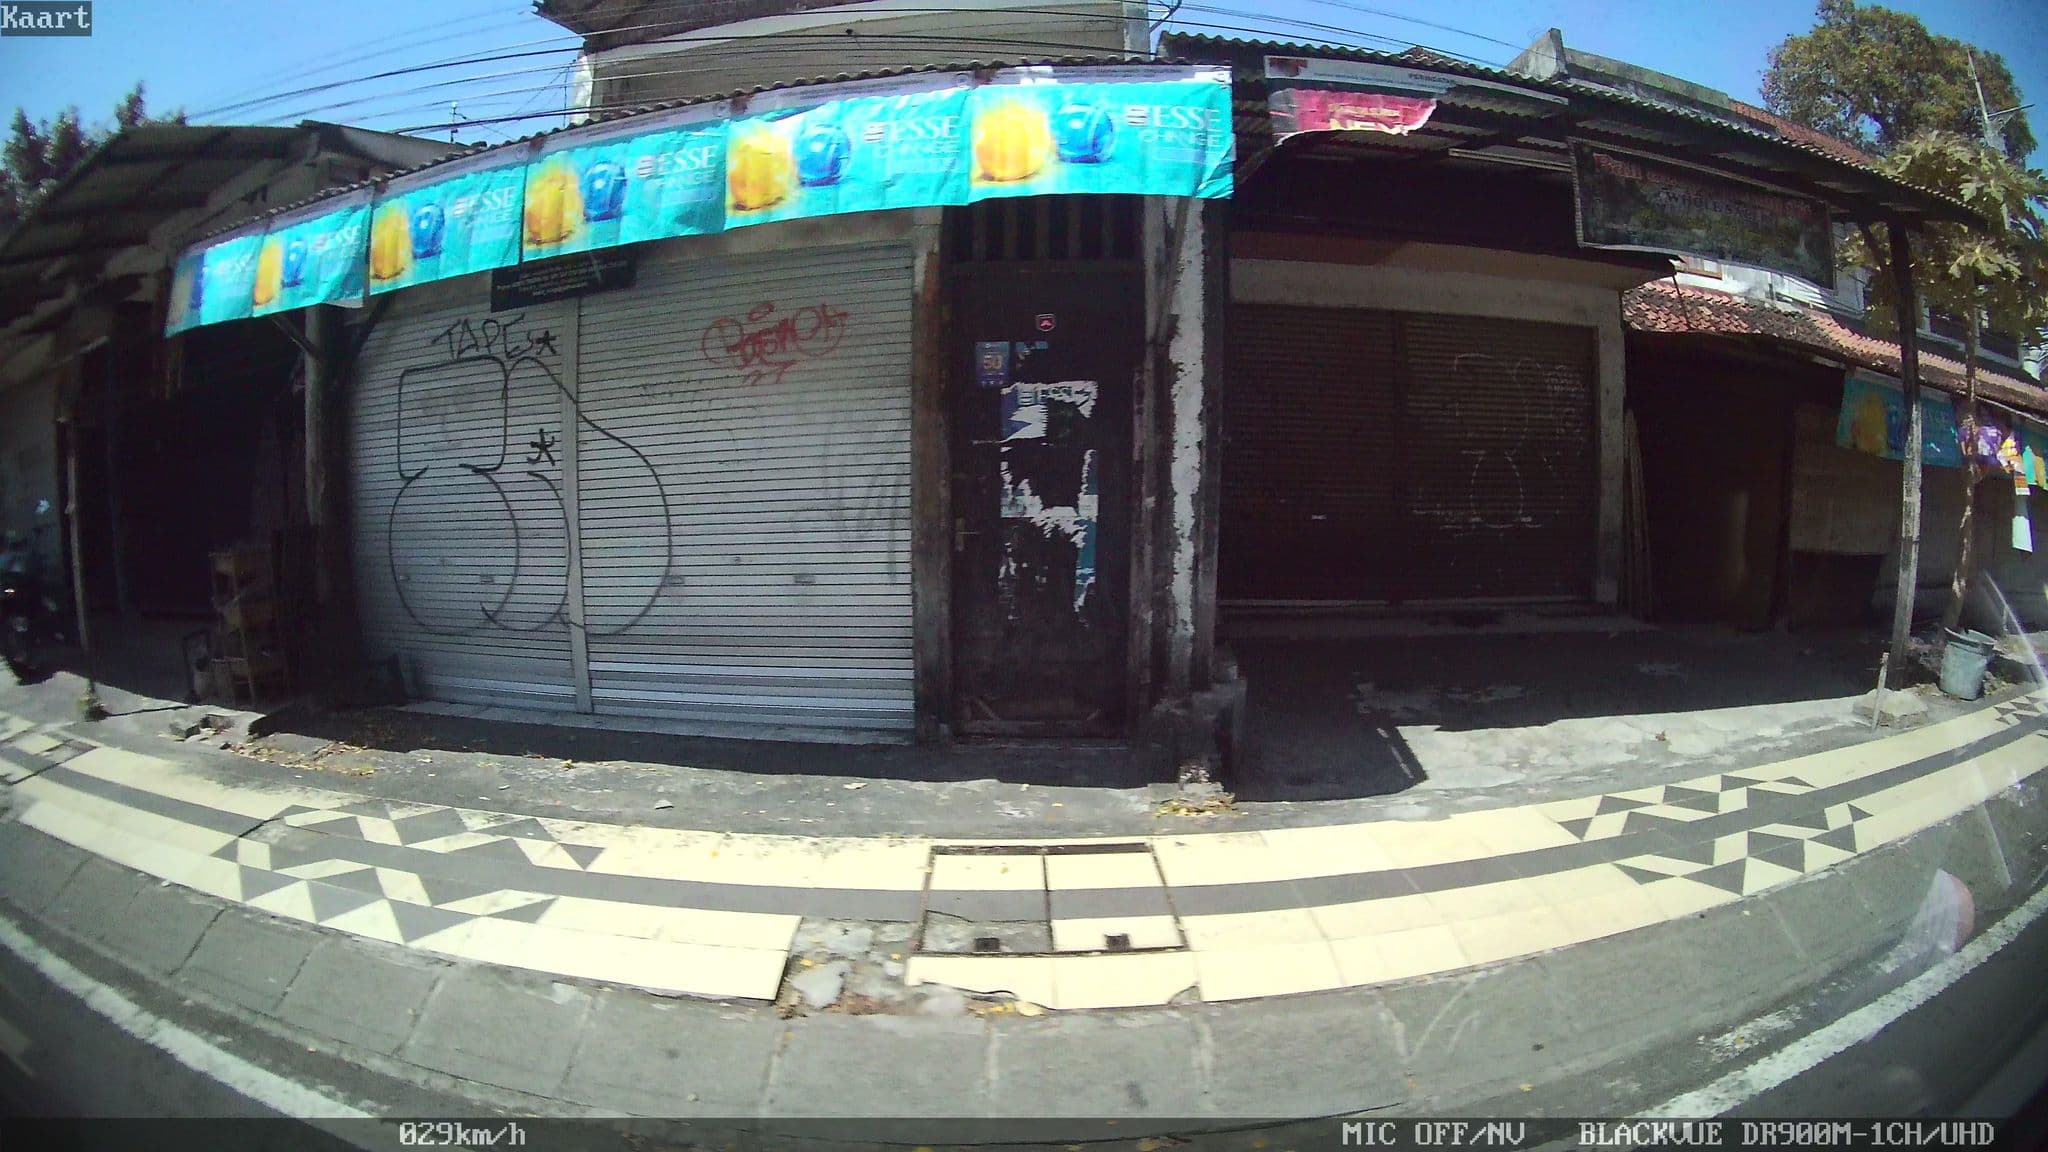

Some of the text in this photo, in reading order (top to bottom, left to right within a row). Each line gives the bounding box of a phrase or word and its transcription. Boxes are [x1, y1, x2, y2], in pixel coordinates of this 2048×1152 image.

[889, 115, 960, 140] ESSE
[1152, 105, 1223, 132] ESSE
[656, 145, 718, 176] ESSE
